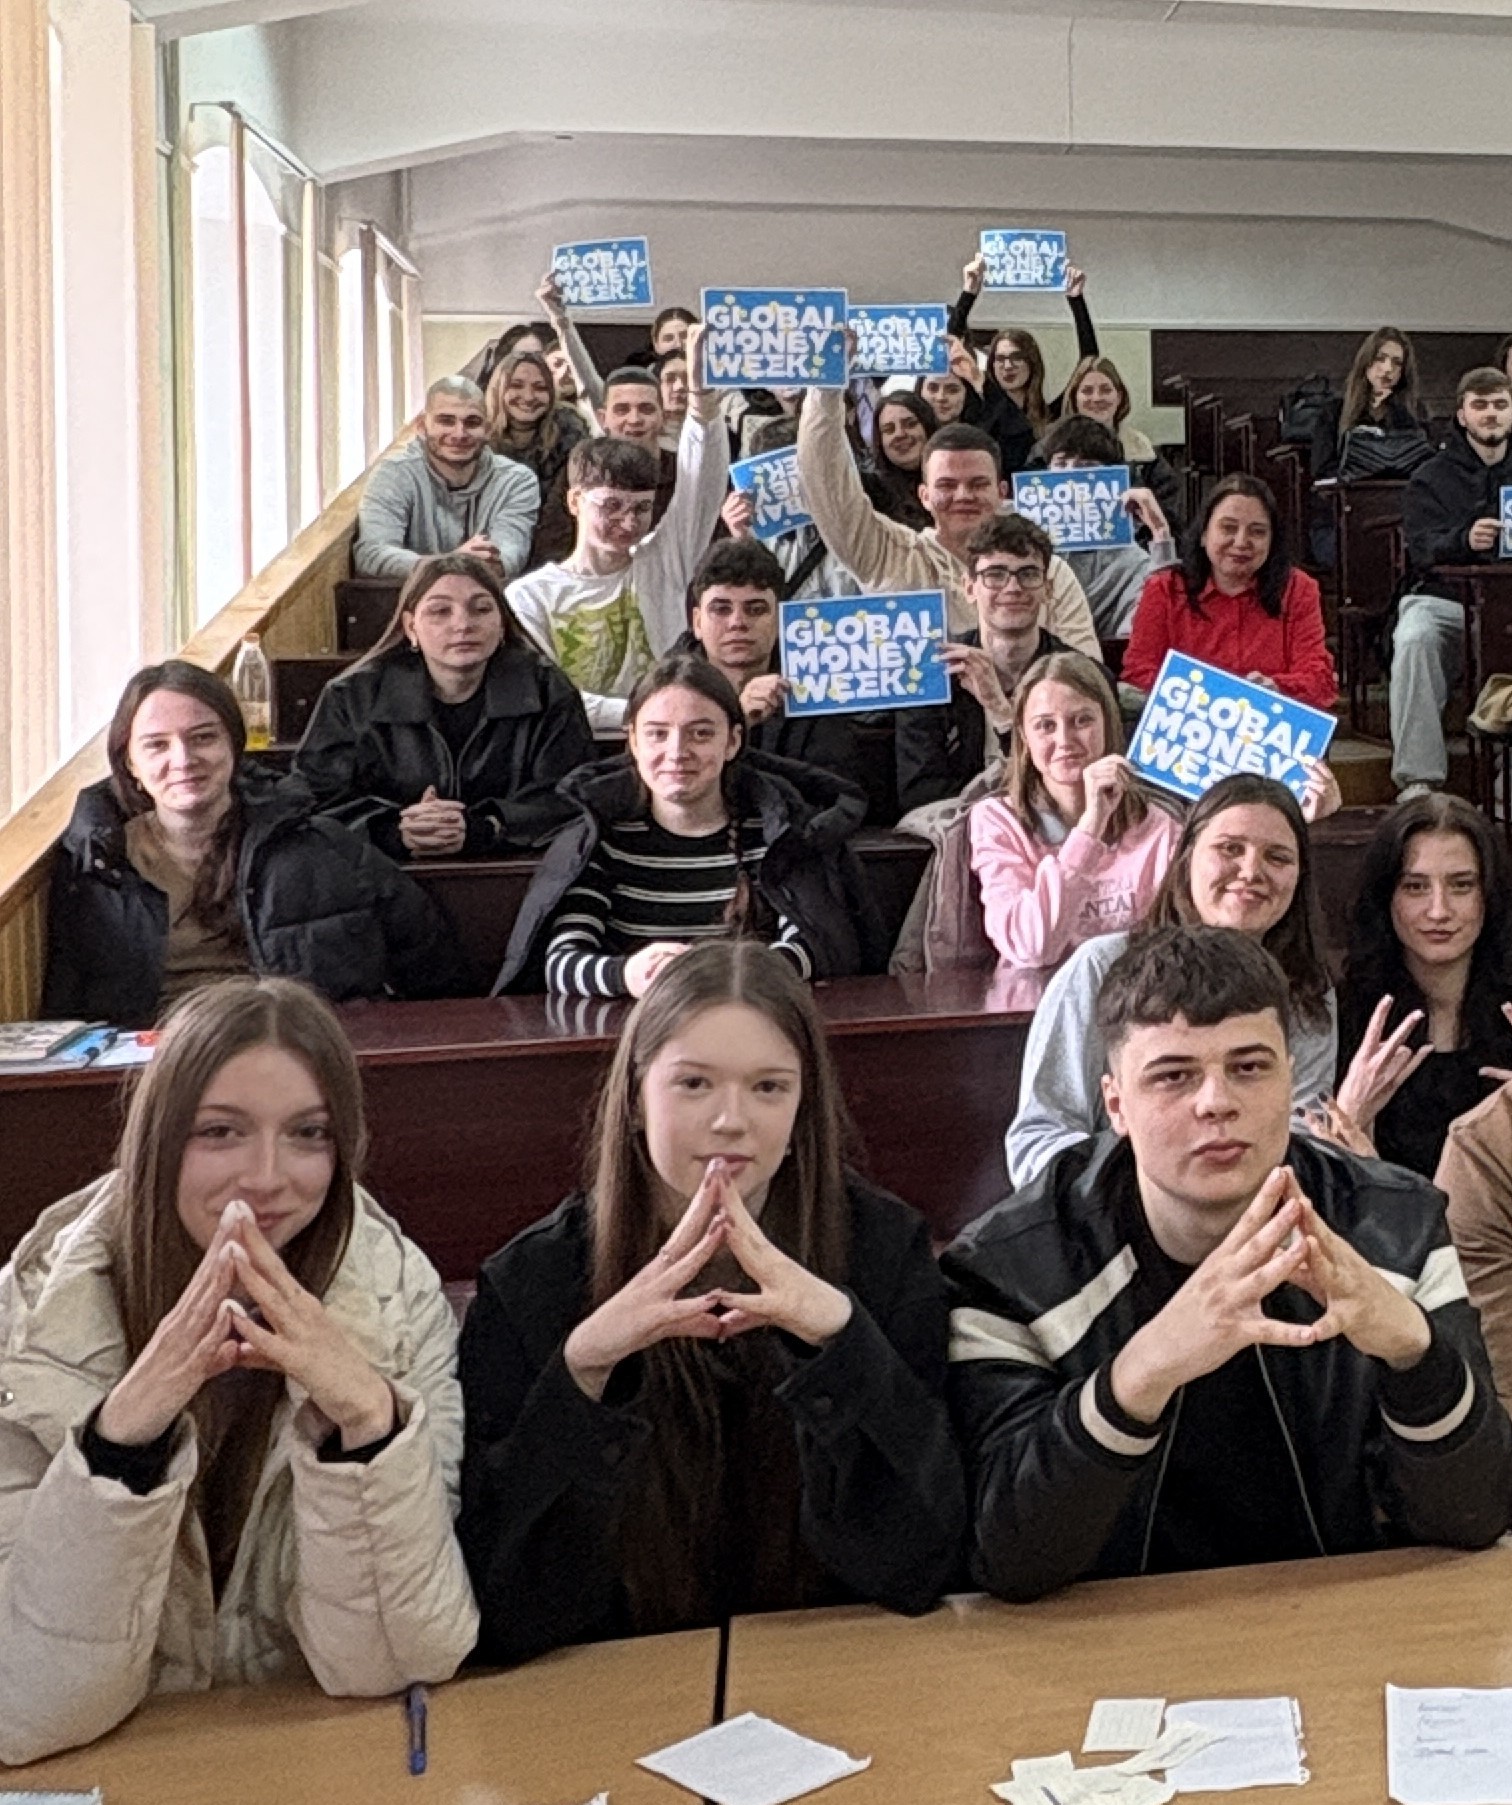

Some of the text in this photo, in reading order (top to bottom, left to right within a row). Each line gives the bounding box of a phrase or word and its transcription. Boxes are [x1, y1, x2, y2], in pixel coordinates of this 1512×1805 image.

[555, 248, 646, 270] GLOBAL
[983, 240, 1064, 257] GLOBAL
[983, 254, 1058, 273] MONEY
[555, 266, 637, 288] MONEY
[707, 305, 845, 330] GLOBAL
[849, 317, 945, 337] GLOBAL
[708, 329, 832, 354] MONEY
[708, 353, 811, 380] WEEK
[1018, 480, 1123, 506] GLOBAL
[1042, 521, 1102, 546] EEK
[786, 610, 942, 648] GLOBAL
[787, 638, 928, 676] MONEY
[788, 668, 908, 704] WEEK
[1160, 676, 1317, 766] GLOBAL
[1145, 704, 1298, 780] MONEY
[1139, 731, 1234, 790] WEE
